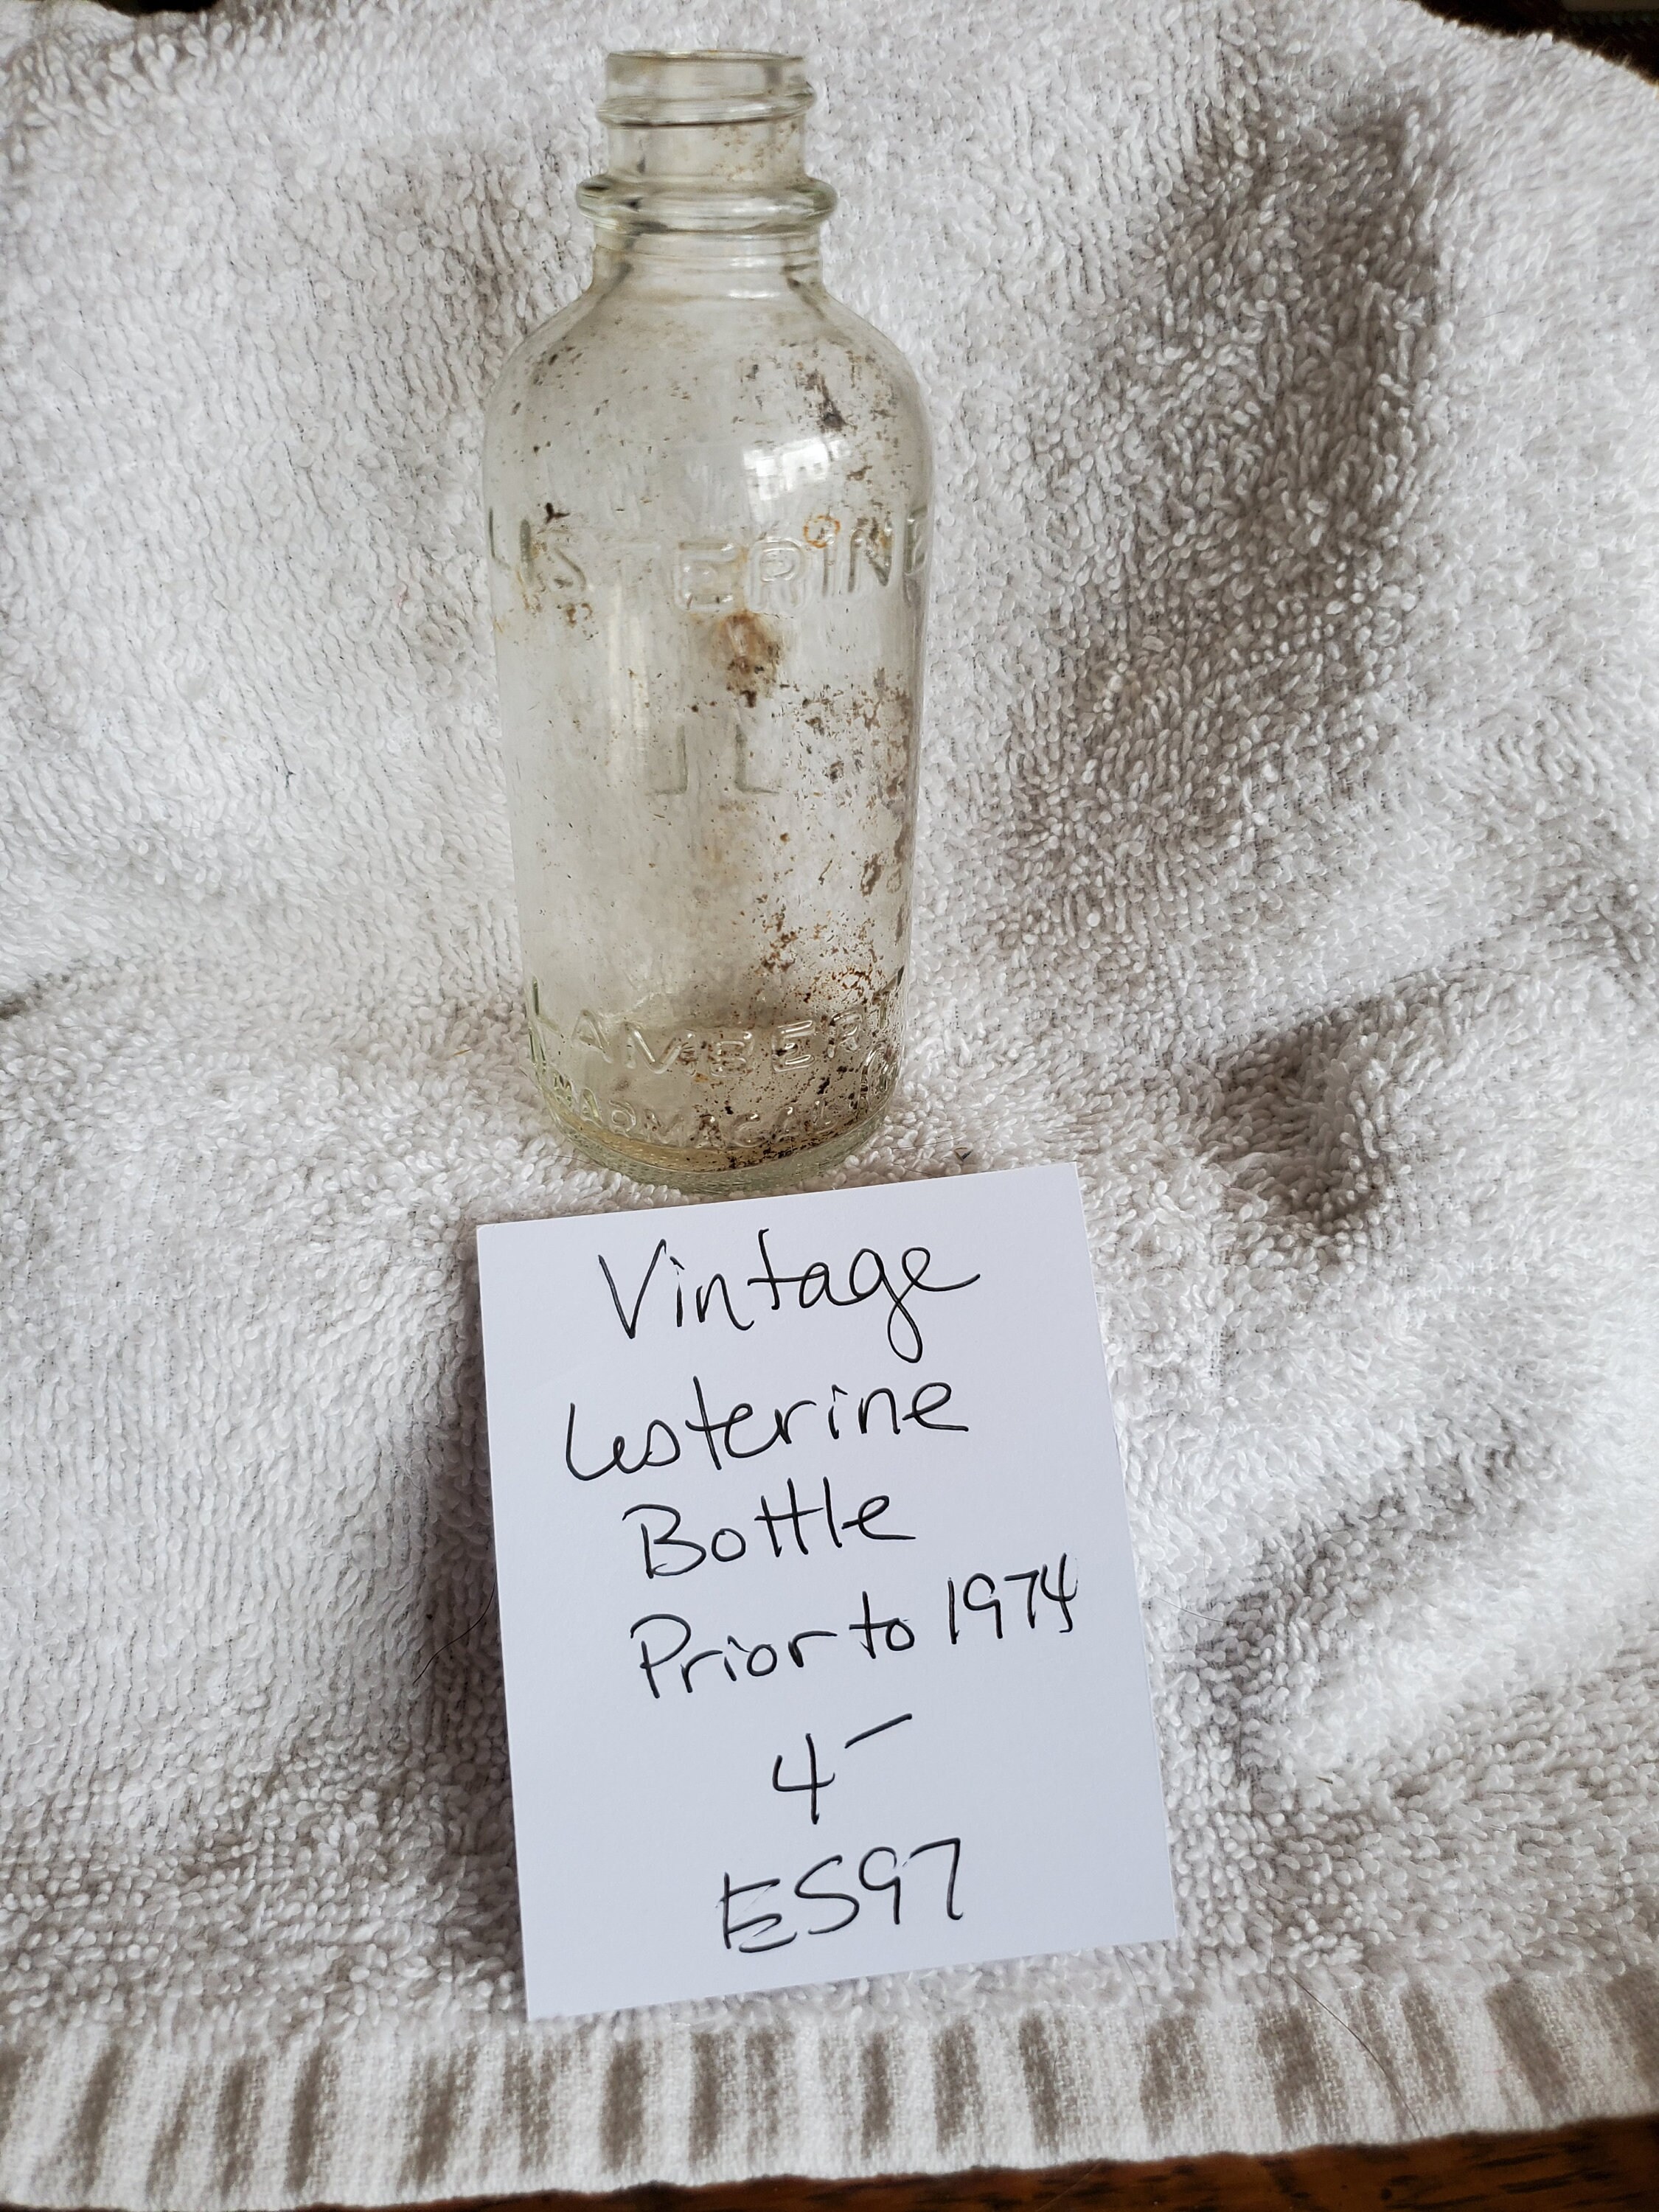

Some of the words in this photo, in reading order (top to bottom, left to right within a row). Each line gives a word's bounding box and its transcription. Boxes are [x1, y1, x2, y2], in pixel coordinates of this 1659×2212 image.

[597, 1227, 981, 1364] Vintage
[622, 1476, 917, 1579] Bottle
[630, 1613, 838, 1699] Prior
[848, 1590, 916, 1660] to
[947, 1553, 1079, 1646] 1974
[718, 1837, 964, 1954] ES97
